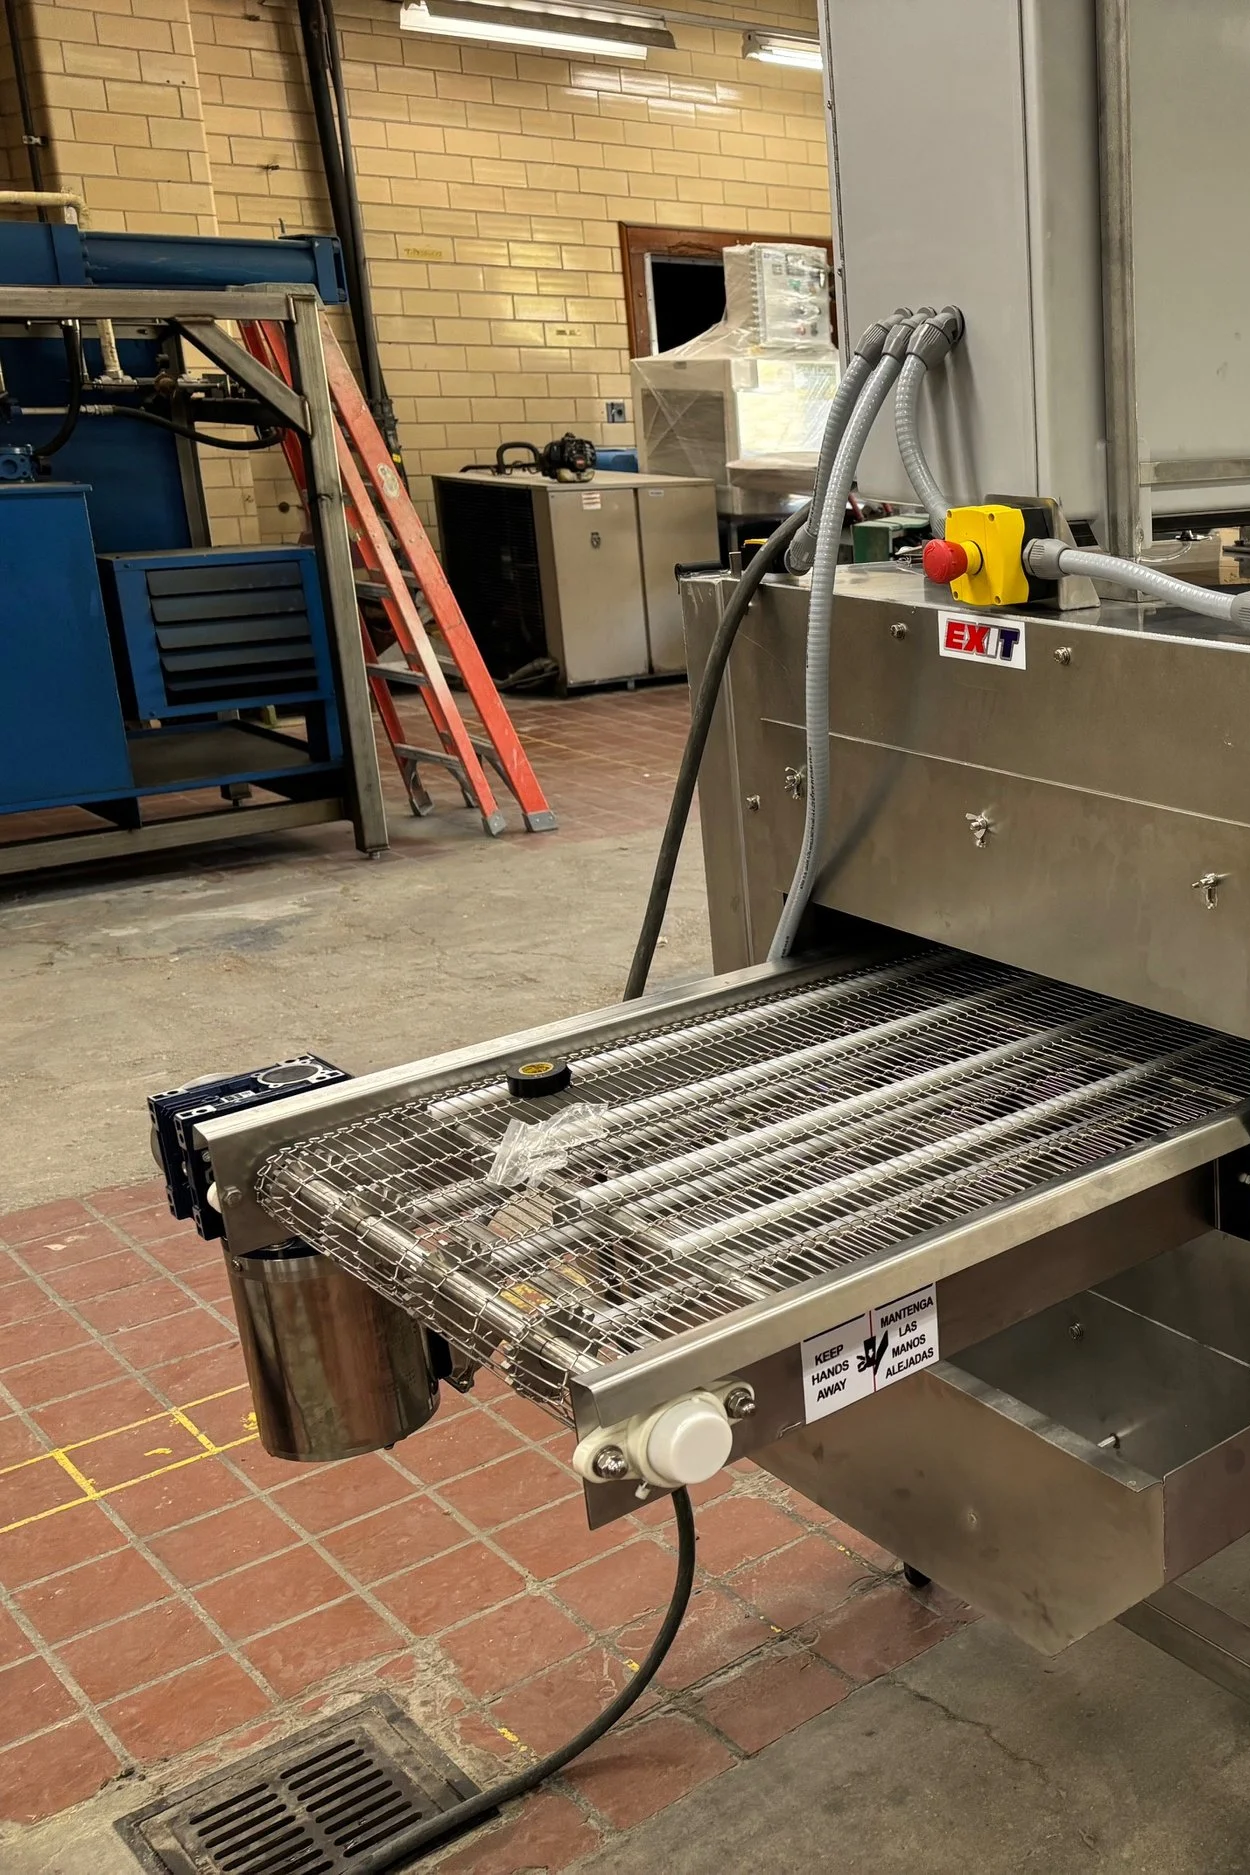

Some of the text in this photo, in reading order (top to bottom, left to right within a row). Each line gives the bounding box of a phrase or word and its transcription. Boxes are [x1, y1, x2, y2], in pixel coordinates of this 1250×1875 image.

[944, 618, 1020, 661] EXIT
[880, 1296, 934, 1329] MANTENGA
[898, 1320, 918, 1338] LAS
[814, 1344, 844, 1366] KEEP
[891, 1333, 926, 1359] MANOS
[811, 1360, 850, 1386] HANDS
[885, 1347, 934, 1379] ALEJADAS
[816, 1378, 847, 1402] AWAY
